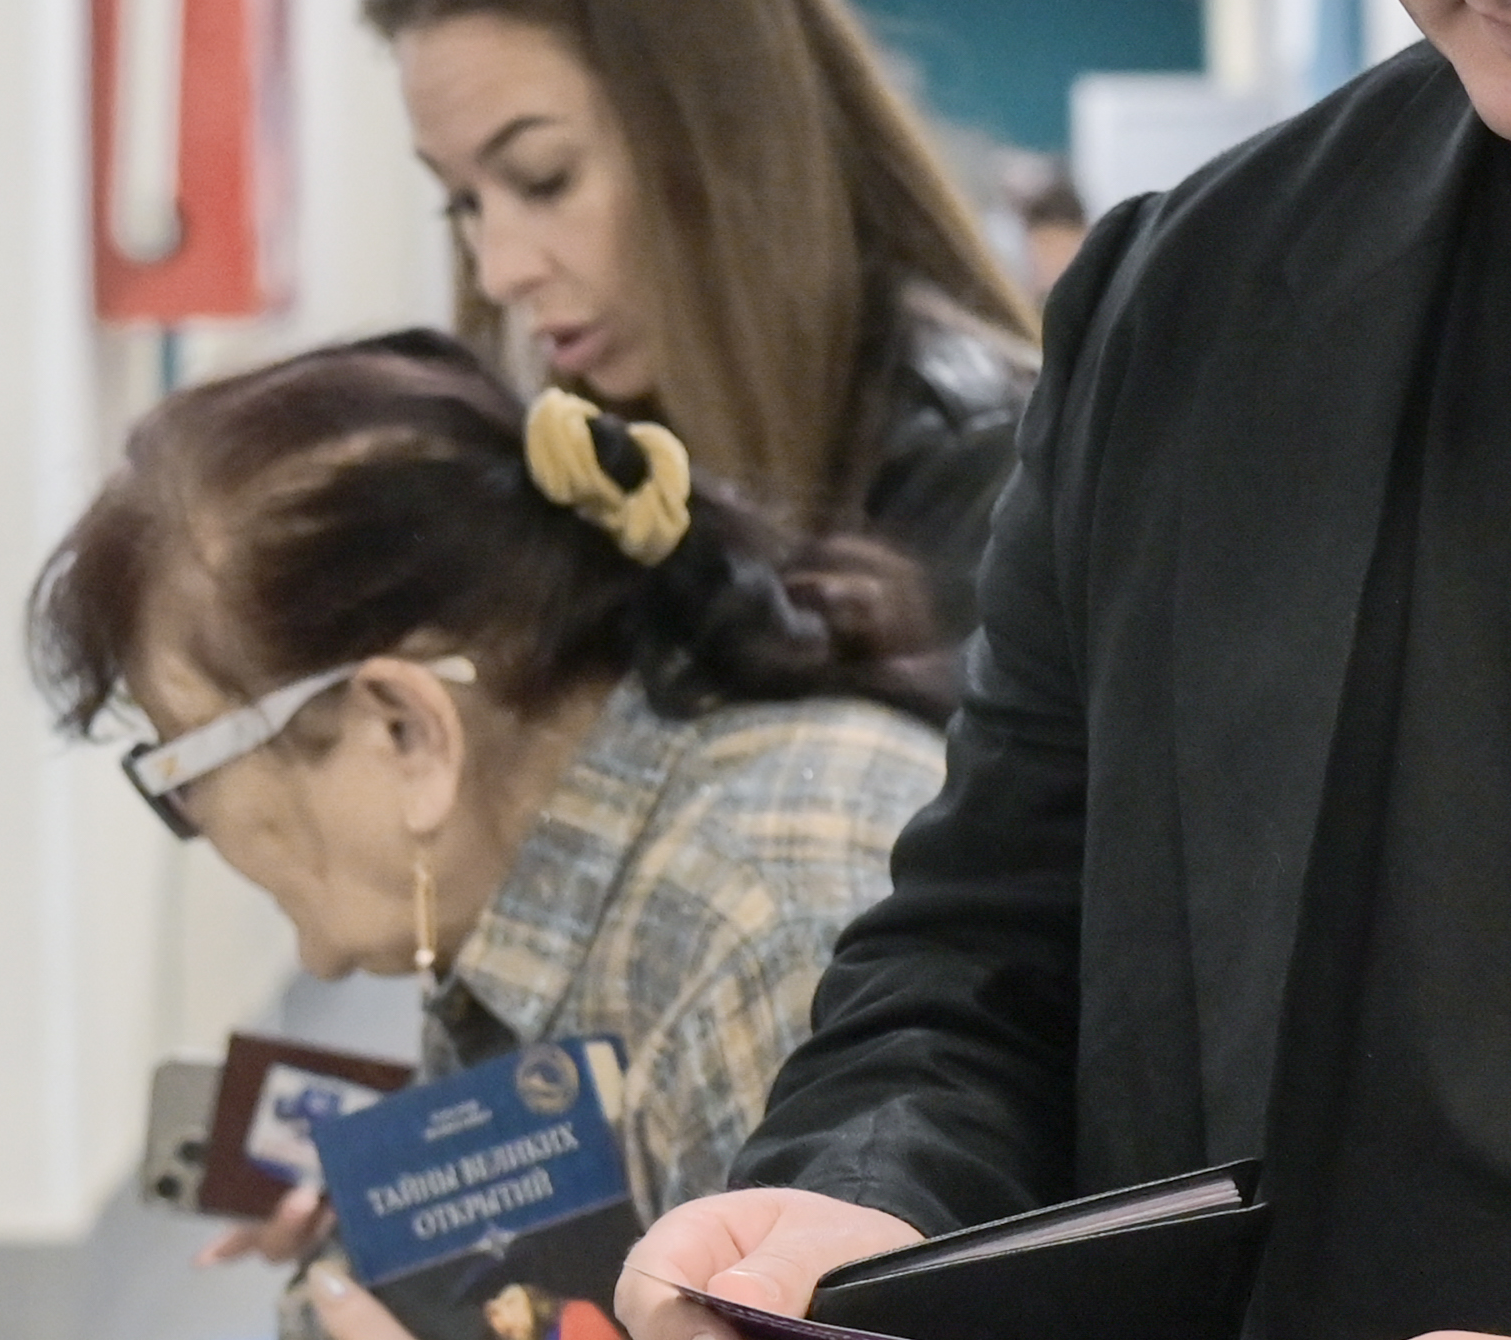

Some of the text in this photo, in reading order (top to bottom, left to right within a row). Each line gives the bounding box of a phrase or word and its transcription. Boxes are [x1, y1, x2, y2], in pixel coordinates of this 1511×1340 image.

[367, 1162, 460, 1217] ТАЙНЫ
[457, 1120, 580, 1186] ВЕЛИКИХ
[412, 1165, 554, 1240] ОТКРЫТИЙ
